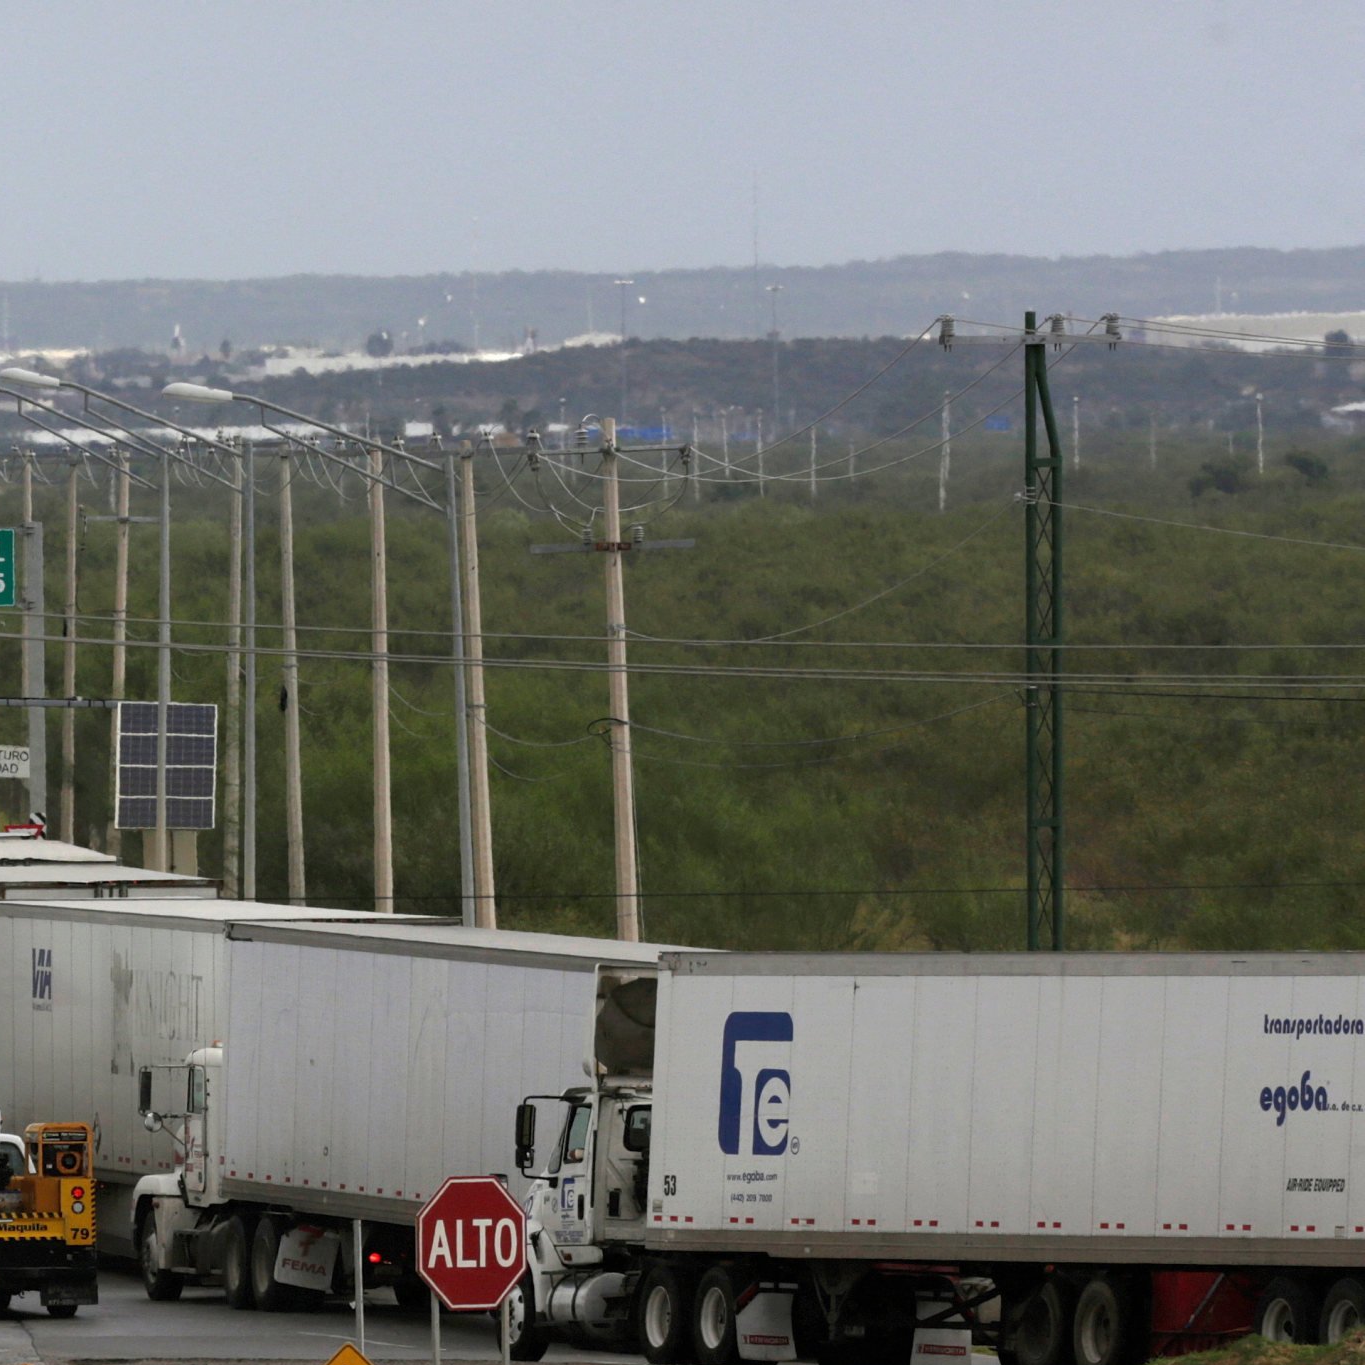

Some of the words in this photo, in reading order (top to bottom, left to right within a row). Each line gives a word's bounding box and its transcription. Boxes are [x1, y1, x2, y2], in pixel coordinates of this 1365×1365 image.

[1263, 1014, 1364, 1041] transportadora
[1259, 1069, 1328, 1127] egoba
[663, 1174, 677, 1197] 53
[726, 1169, 778, 1185] www.egoba.com
[1313, 1177, 1346, 1193] EQUIPPED
[71, 1228, 90, 1240] 79
[427, 1217, 518, 1269] ALTO
[281, 1257, 327, 1277] FEMA
